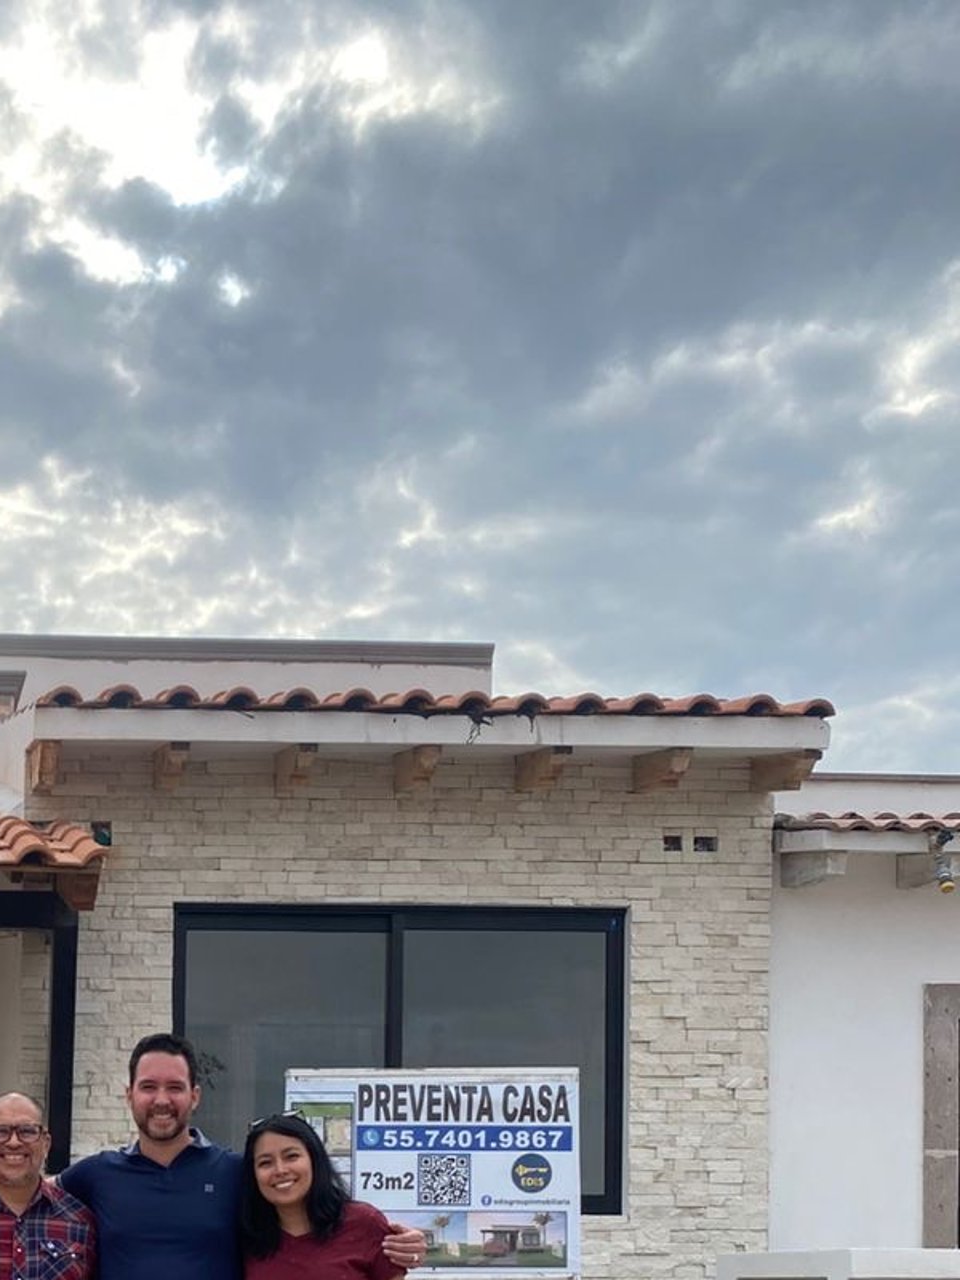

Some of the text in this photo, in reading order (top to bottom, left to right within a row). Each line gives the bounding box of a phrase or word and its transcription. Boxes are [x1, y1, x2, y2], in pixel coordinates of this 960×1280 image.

[358, 1084, 571, 1123] PREVENTA CASA
[383, 1130, 564, 1148] 55.7401.9867
[360, 1172, 414, 1191] 73m2
